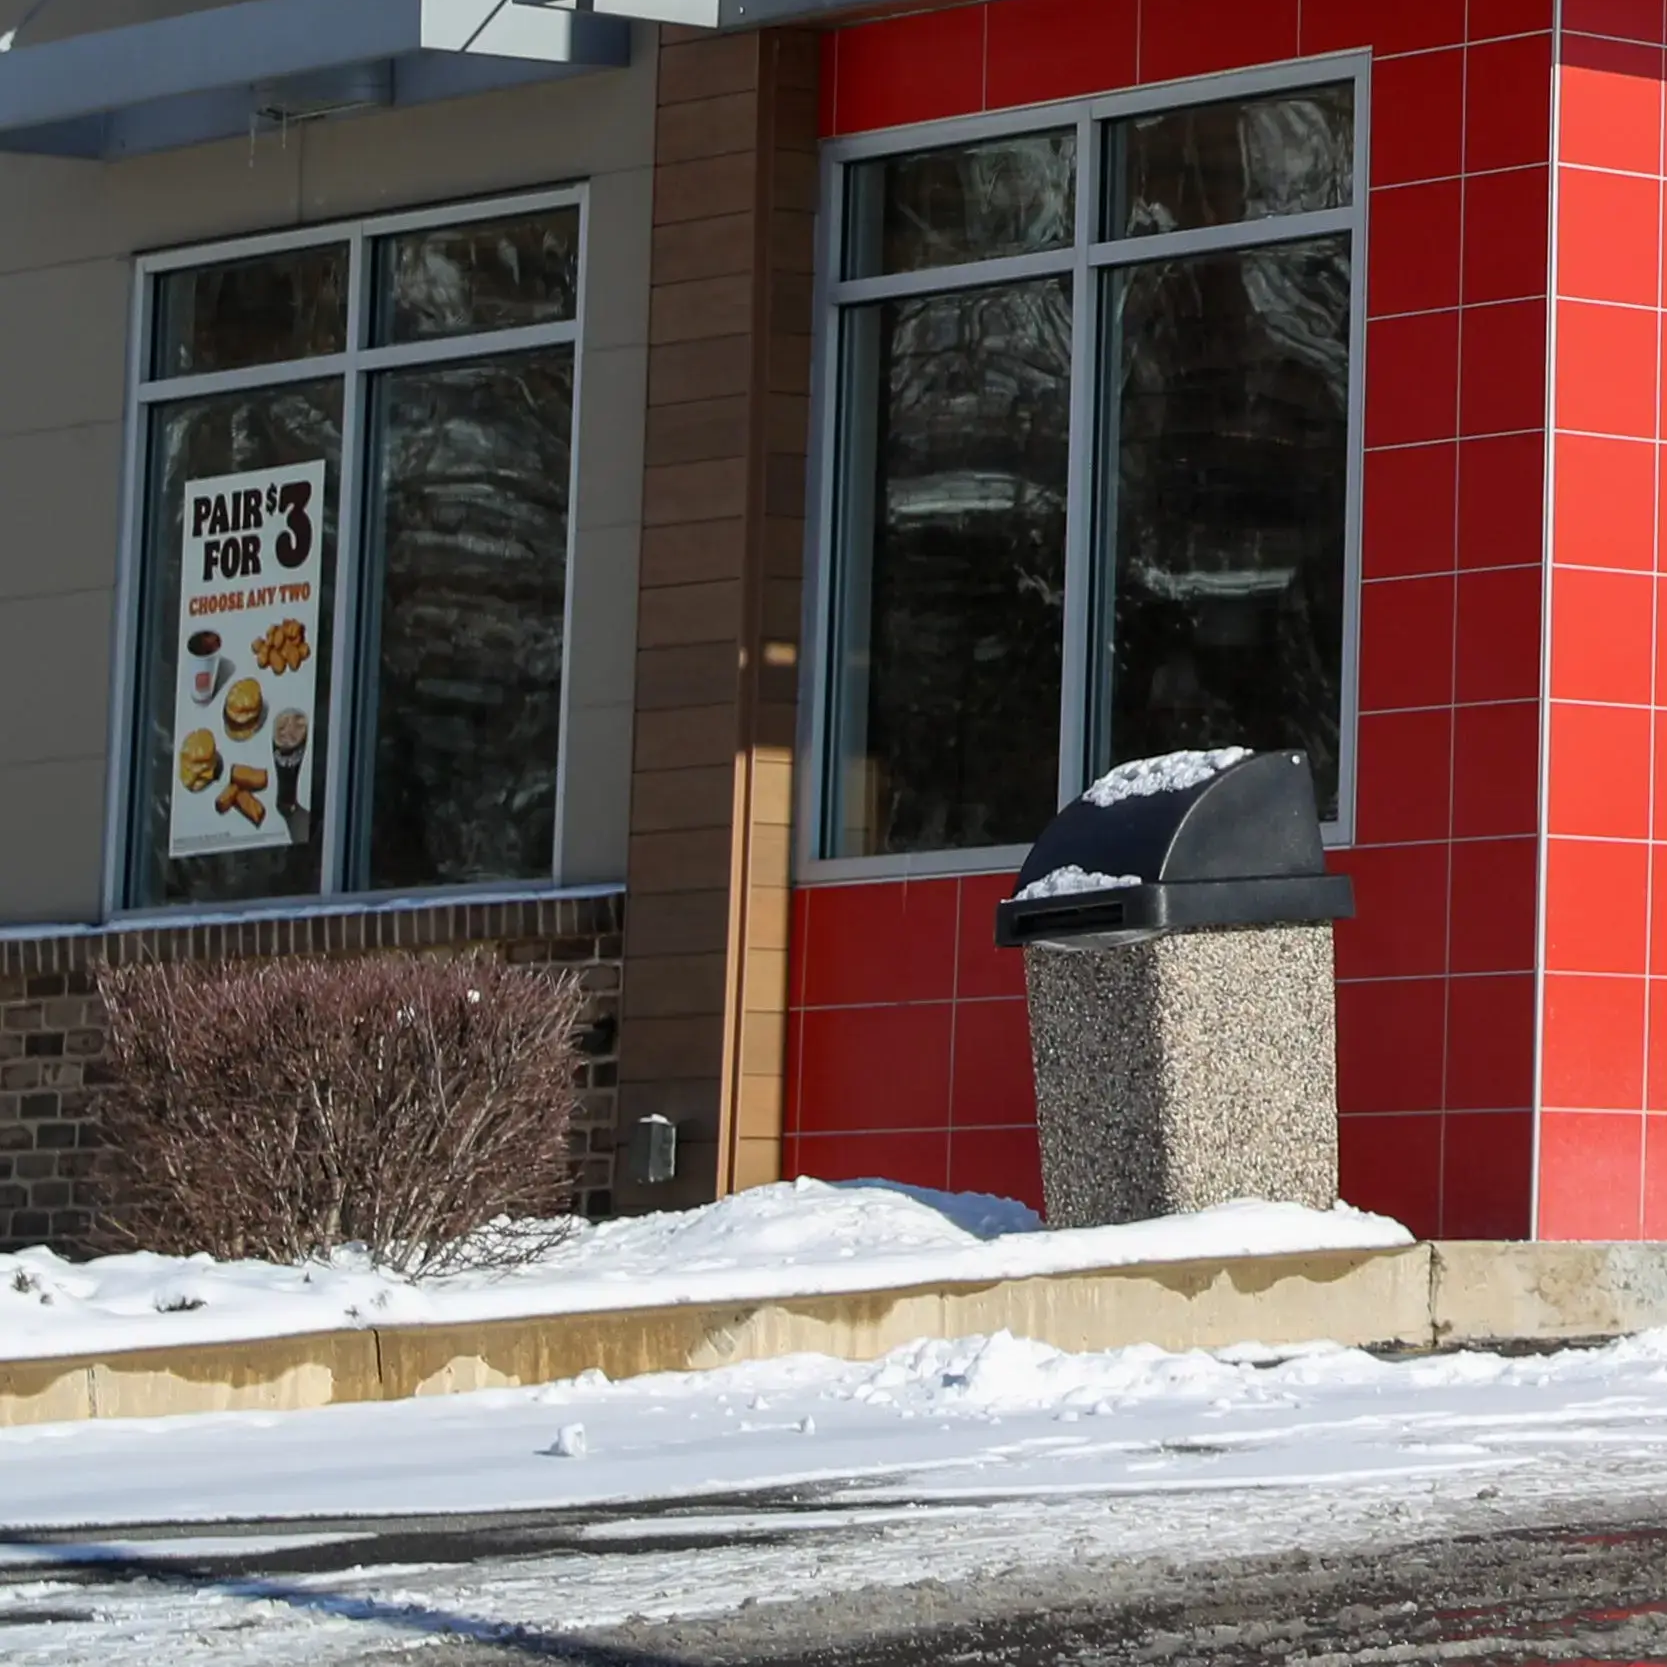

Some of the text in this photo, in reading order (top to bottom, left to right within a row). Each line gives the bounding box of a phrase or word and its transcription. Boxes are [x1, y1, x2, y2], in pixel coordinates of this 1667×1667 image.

[192, 480, 312, 569] PAIR $3
[203, 535, 261, 582] FOR
[189, 581, 311, 617] CHOOSE ANY TWO
